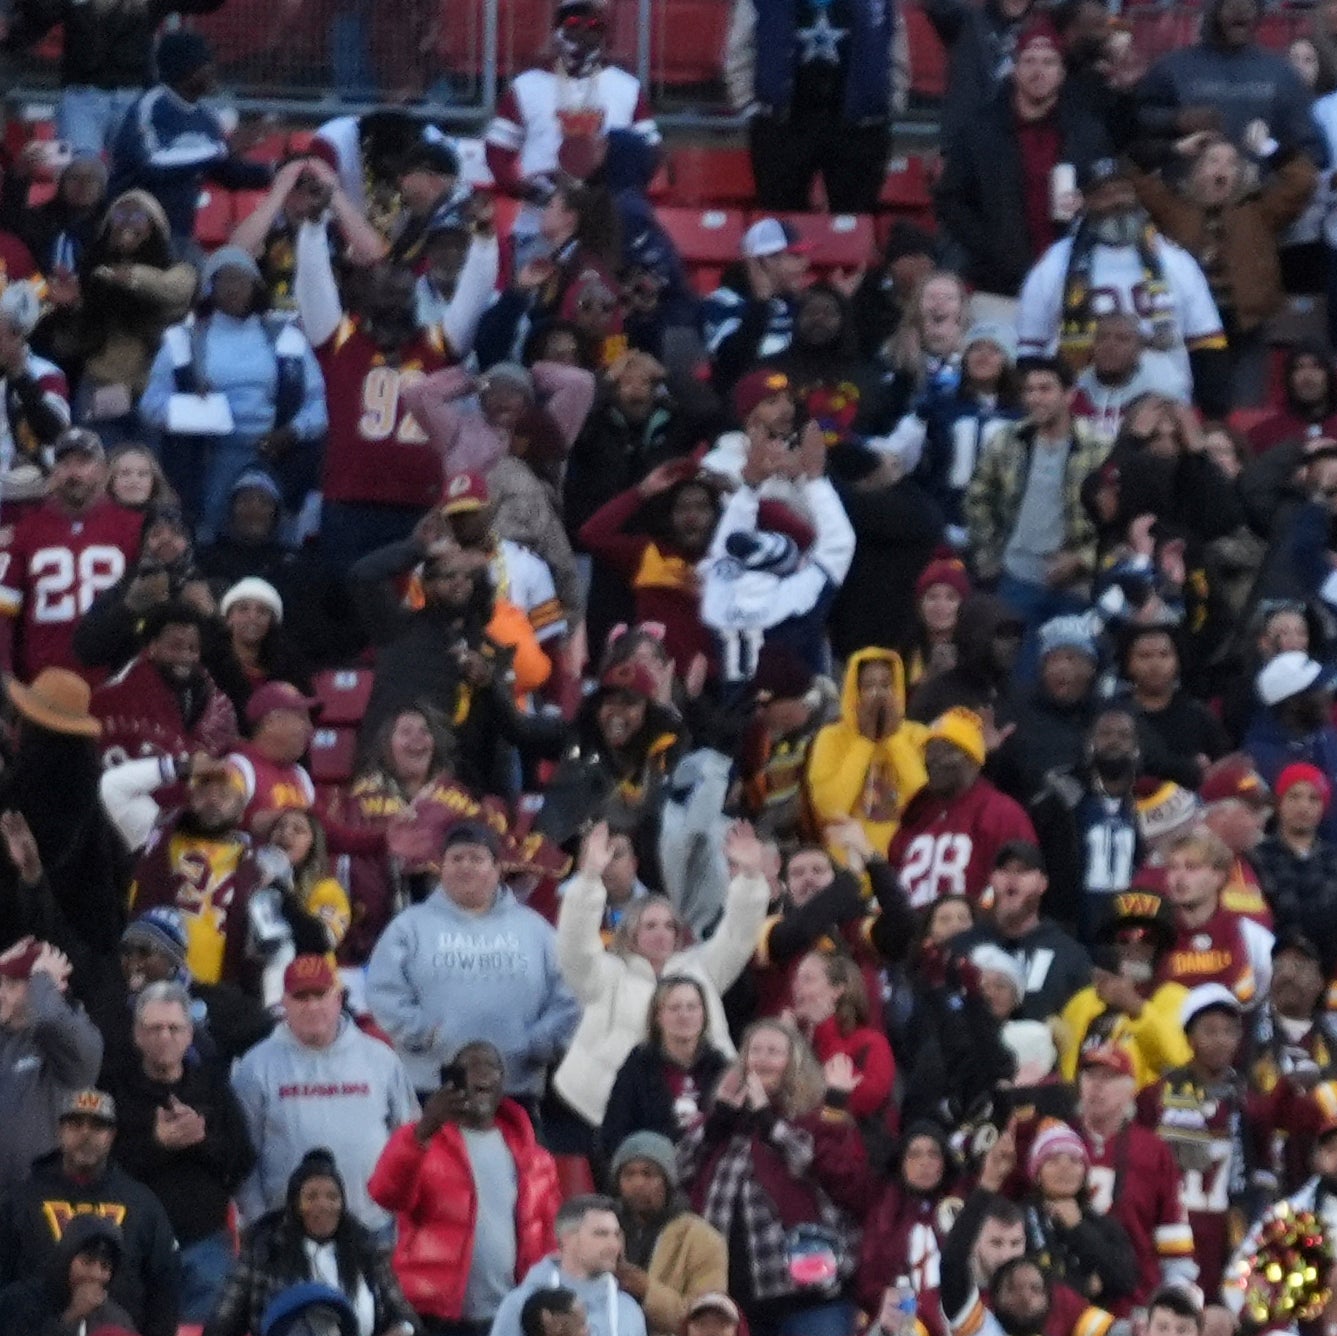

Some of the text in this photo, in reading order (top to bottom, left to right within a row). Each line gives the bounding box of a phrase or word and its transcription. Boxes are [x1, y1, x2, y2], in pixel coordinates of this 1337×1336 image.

[32, 546, 127, 624] 28
[900, 832, 974, 907] 28
[1085, 824, 1136, 891] 11
[432, 951, 530, 972] COWBOYS
[438, 933, 519, 951] DALLAS
